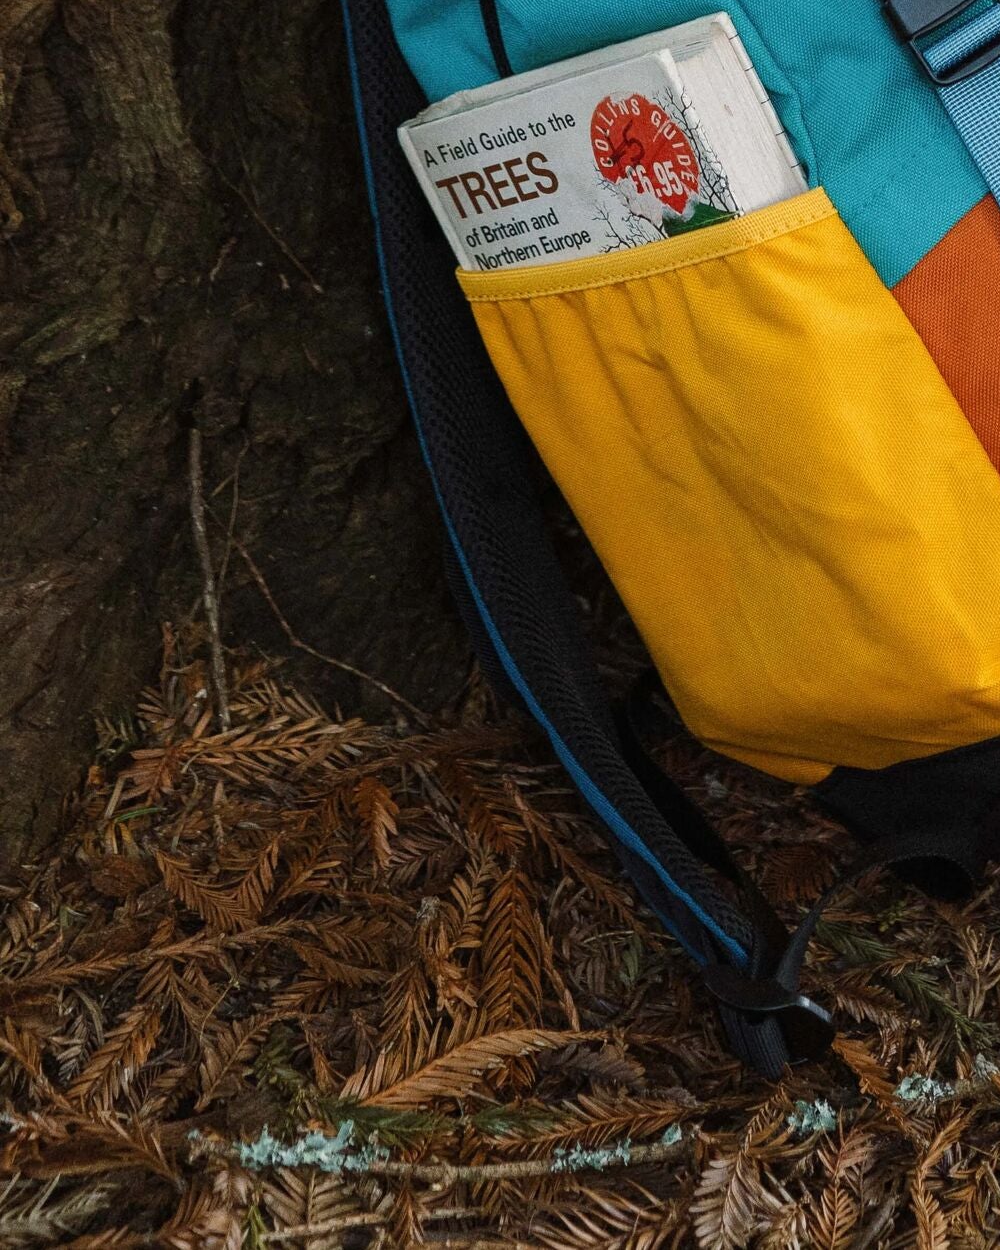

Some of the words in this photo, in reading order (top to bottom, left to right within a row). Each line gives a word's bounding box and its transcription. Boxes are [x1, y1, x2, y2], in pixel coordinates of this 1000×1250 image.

[424, 150, 438, 168] A
[437, 137, 478, 163] Field
[479, 125, 527, 151] Guide
[528, 120, 547, 137] to
[547, 113, 576, 132] the
[595, 98, 640, 168] COLLINS
[651, 110, 696, 183] GUIDE
[435, 151, 559, 219] TREES
[466, 228, 482, 248] of
[481, 218, 530, 244] Britain
[532, 207, 560, 230] and
[474, 243, 541, 271] Northern
[539, 229, 592, 253] Europe
